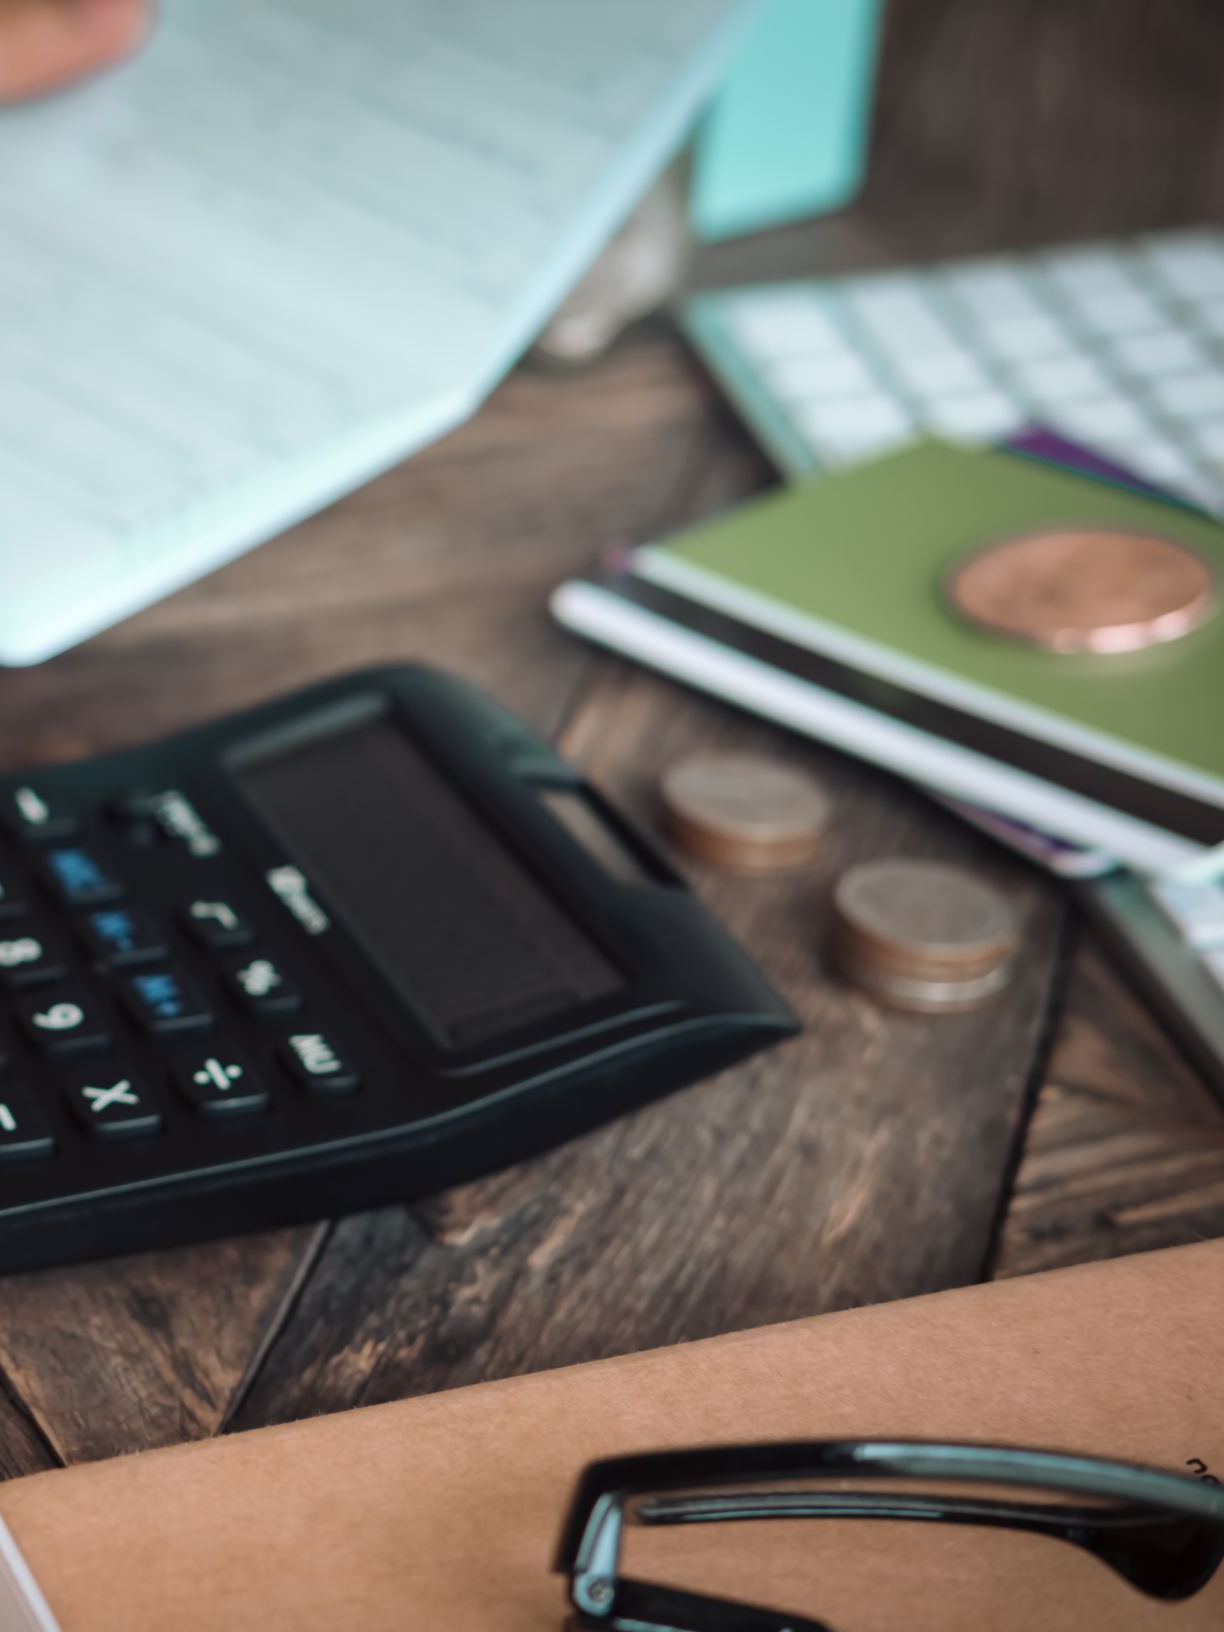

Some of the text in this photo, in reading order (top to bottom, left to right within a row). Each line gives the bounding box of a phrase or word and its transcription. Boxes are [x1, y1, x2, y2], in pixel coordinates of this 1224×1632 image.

[32, 1001, 85, 1033] 9
[288, 1032, 343, 1076] MU
[192, 1057, 244, 1092] ÷
